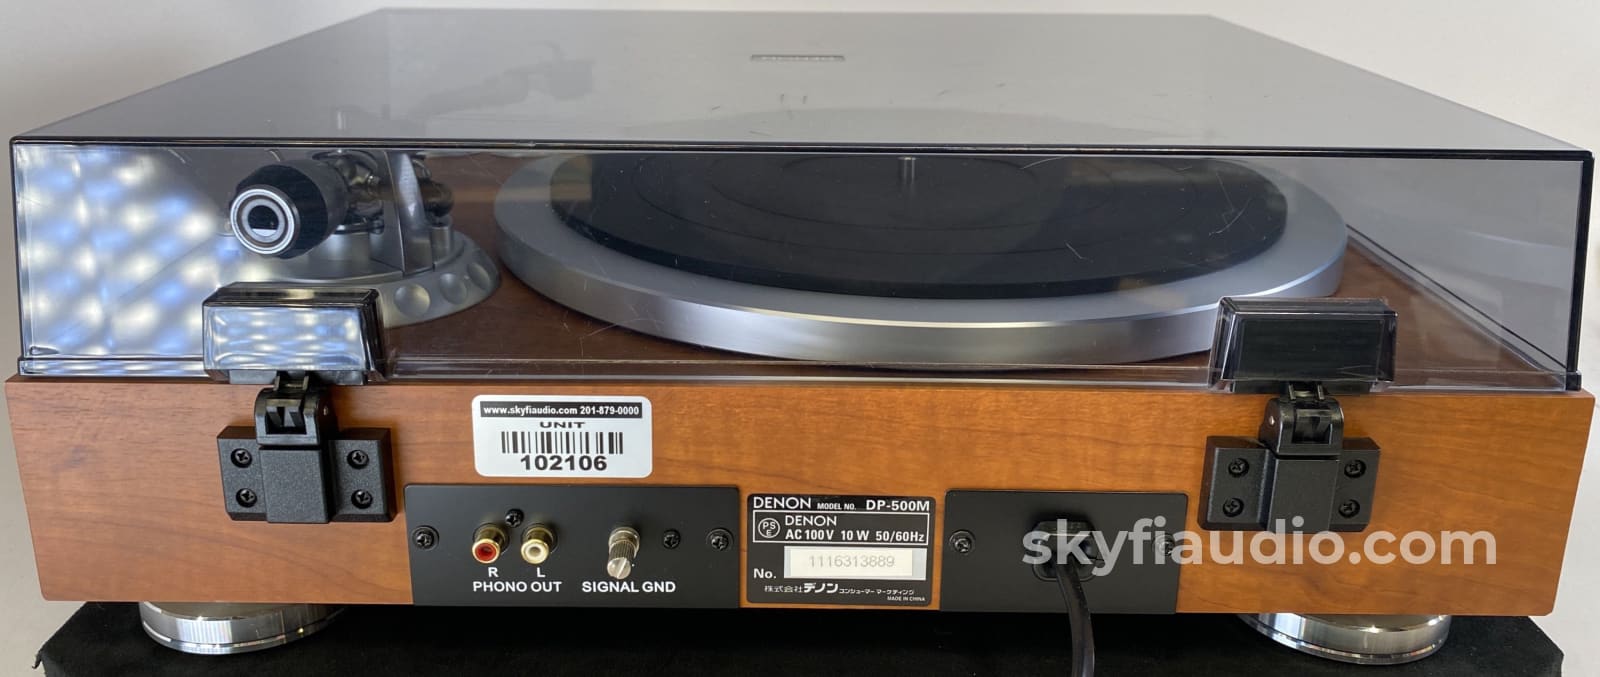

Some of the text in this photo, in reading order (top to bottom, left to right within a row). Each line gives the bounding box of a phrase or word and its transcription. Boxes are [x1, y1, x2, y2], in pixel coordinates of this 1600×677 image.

[483, 404, 640, 416] www.skyfiaudio.com 201-879-0000
[540, 421, 586, 429] UNIT
[520, 455, 607, 471] 102106
[753, 496, 812, 509] DENON
[817, 502, 842, 510] MODEL
[866, 500, 930, 511] DP-500M
[785, 515, 838, 526] DENON
[785, 529, 802, 540] AC
[841, 530, 853, 541] 10
[857, 530, 870, 541] W
[875, 531, 925, 543] 50/60Hz
[809, 555, 896, 568] 1116313889
[488, 567, 499, 577] R
[536, 567, 546, 577] L
[753, 568, 777, 579] No.
[473, 581, 563, 592] PHONO OUT
[582, 581, 676, 593] SIGNAL GND
